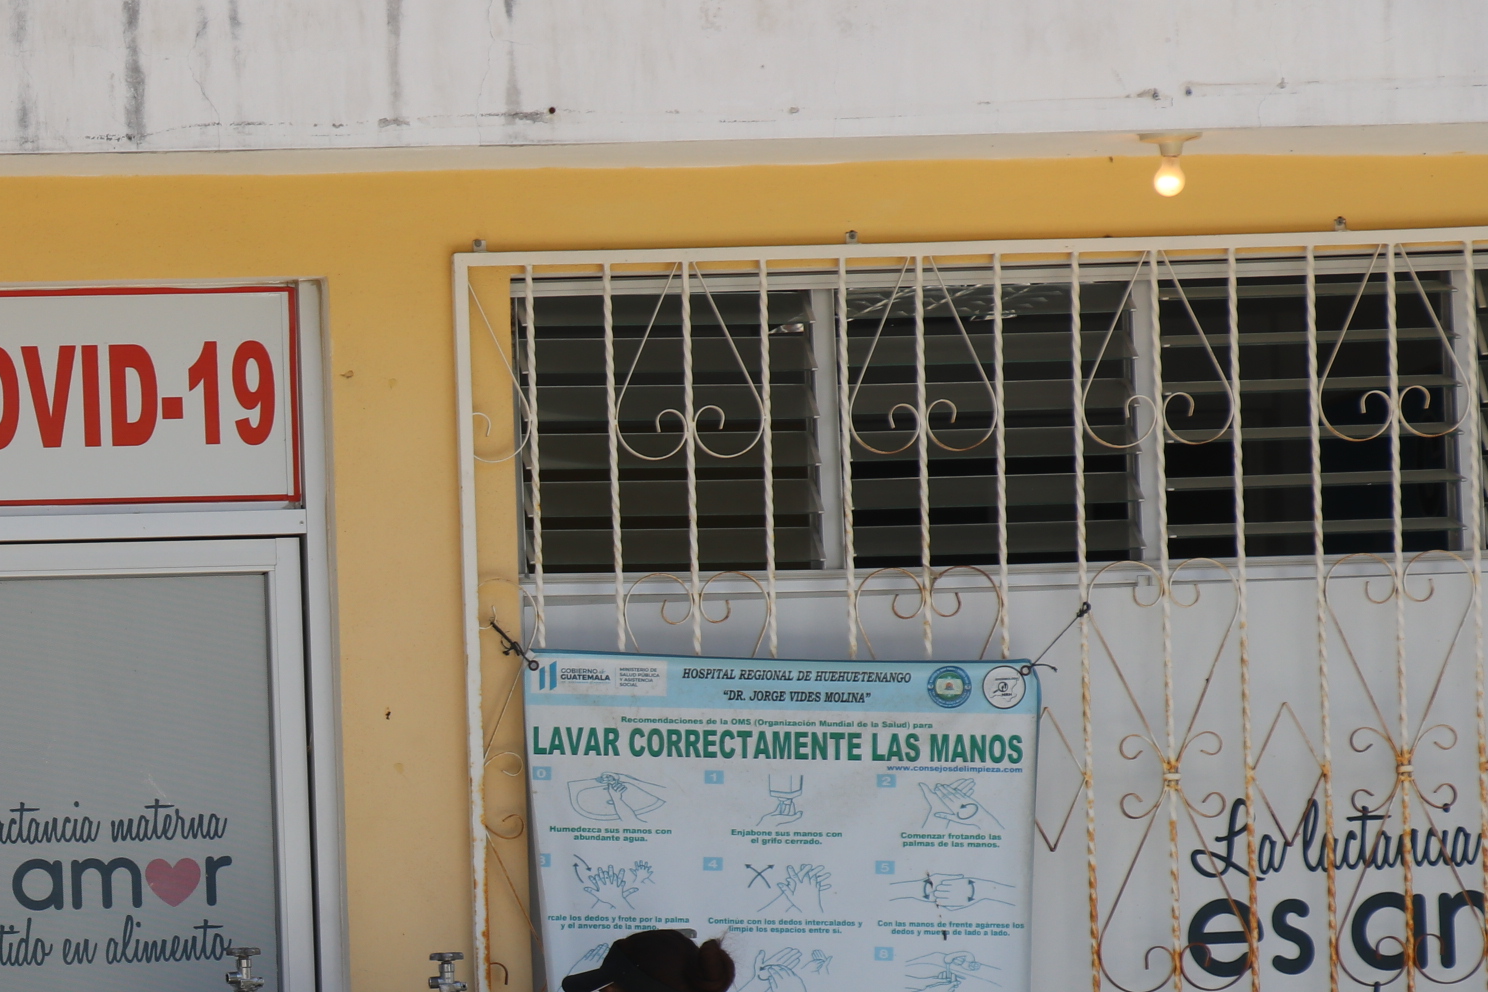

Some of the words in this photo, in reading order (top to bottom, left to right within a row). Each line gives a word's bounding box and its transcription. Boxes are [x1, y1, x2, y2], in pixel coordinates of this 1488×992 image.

[682, 668, 736, 680] HOSPITAL
[739, 669, 793, 681] REGIONAL
[797, 671, 811, 682] DE
[814, 671, 911, 683] HUEHUETENANGO
[749, 690, 786, 702] JORGE
[790, 691, 821, 703] VIDES
[621, 716, 703, 725] Recomendaciones
[731, 718, 752, 726] OMS
[754, 718, 816, 728] (Organización
[819, 720, 855, 728] Mundial
[857, 720, 868, 728] de
[871, 720, 879, 728] la
[882, 720, 910, 729] Salud)
[913, 722, 933, 730] para
[533, 726, 620, 757] LAVAR
[629, 728, 862, 761] CORRECTAMENTE
[872, 733, 921, 763] LAS
[930, 733, 1024, 764] MANOS
[887, 764, 1023, 774] www.consejosdelimpieza.com
[111, 798, 228, 843] materna
[549, 826, 602, 834] Humedezca
[731, 829, 772, 838] Enjabone
[901, 832, 945, 840] Comenzar
[948, 832, 986, 841] frotando
[989, 833, 1002, 841] las
[573, 834, 620, 842] abundante
[623, 835, 648, 844] agua.
[761, 838, 783, 847] grifo
[785, 838, 822, 846] cerrado.
[903, 841, 935, 849] palmas
[937, 840, 948, 848] de
[1191, 798, 1287, 881] La
[1302, 798, 1482, 873] lactancia
[62, 938, 98, 966] en
[106, 915, 231, 964] alimento
[1188, 898, 1315, 977] es
